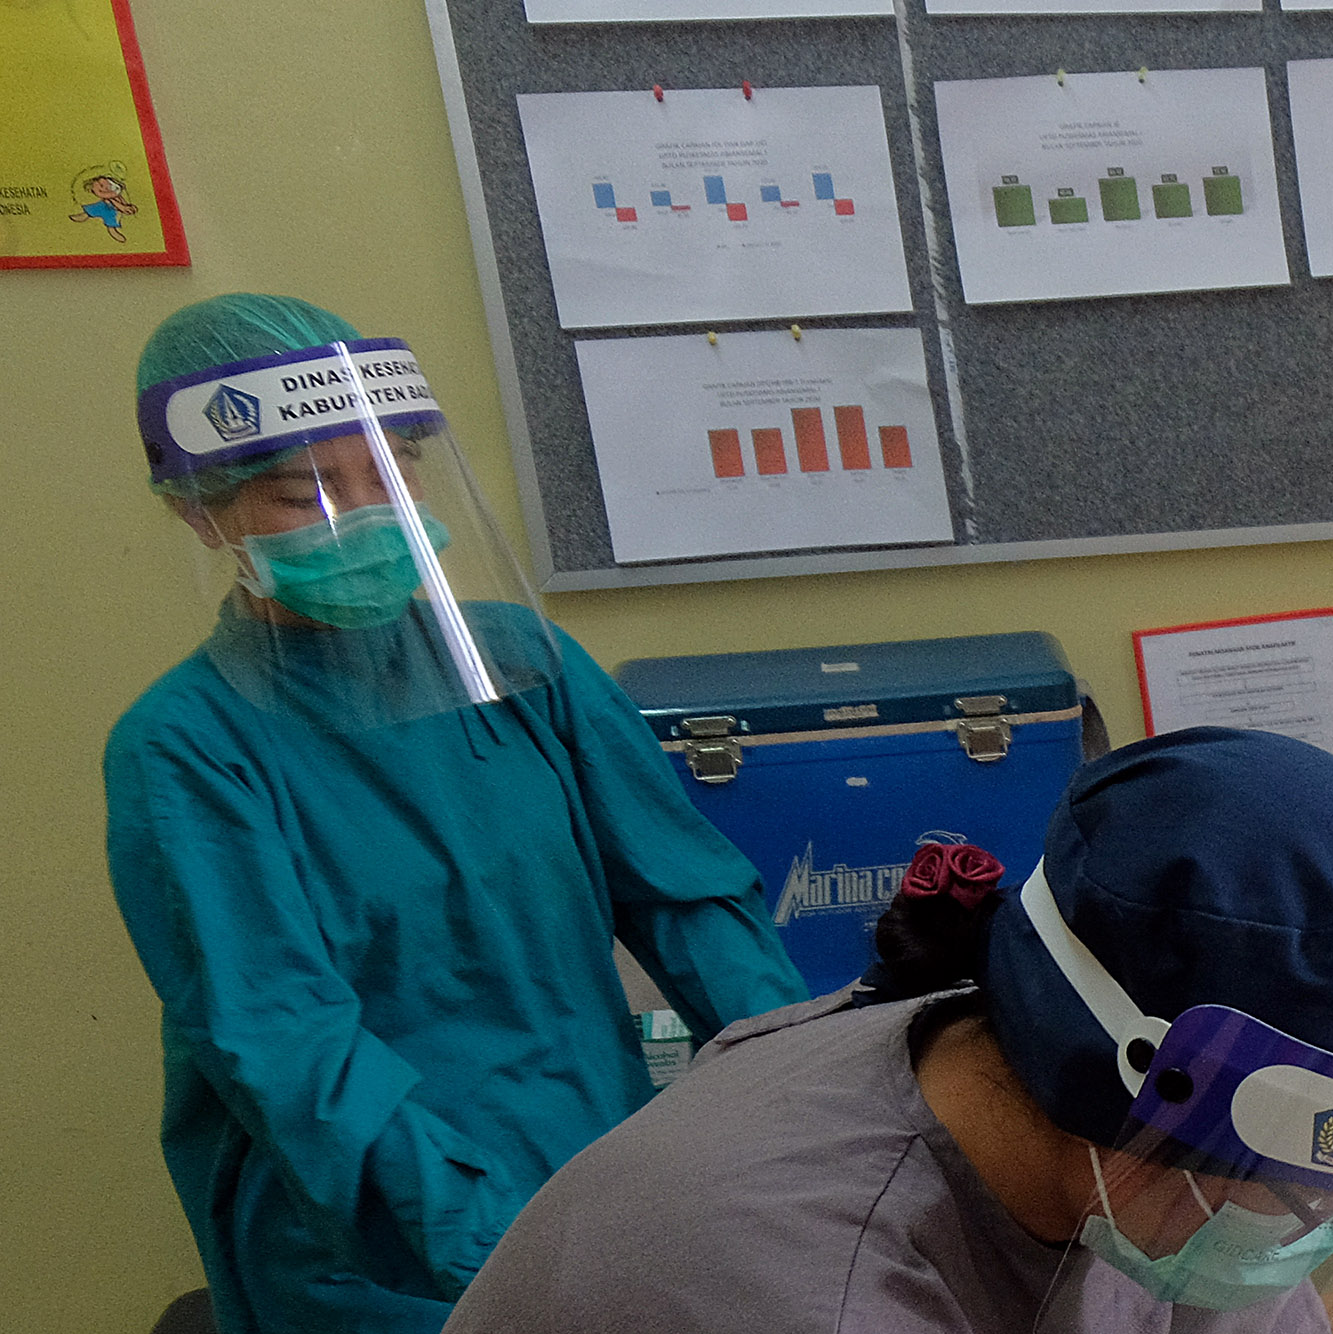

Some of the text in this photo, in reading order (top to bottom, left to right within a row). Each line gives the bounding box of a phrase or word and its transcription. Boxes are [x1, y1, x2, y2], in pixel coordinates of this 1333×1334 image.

[0, 186, 48, 199] KESEHATAN
[281, 366, 355, 393] DINAS
[772, 840, 874, 927] Marina
